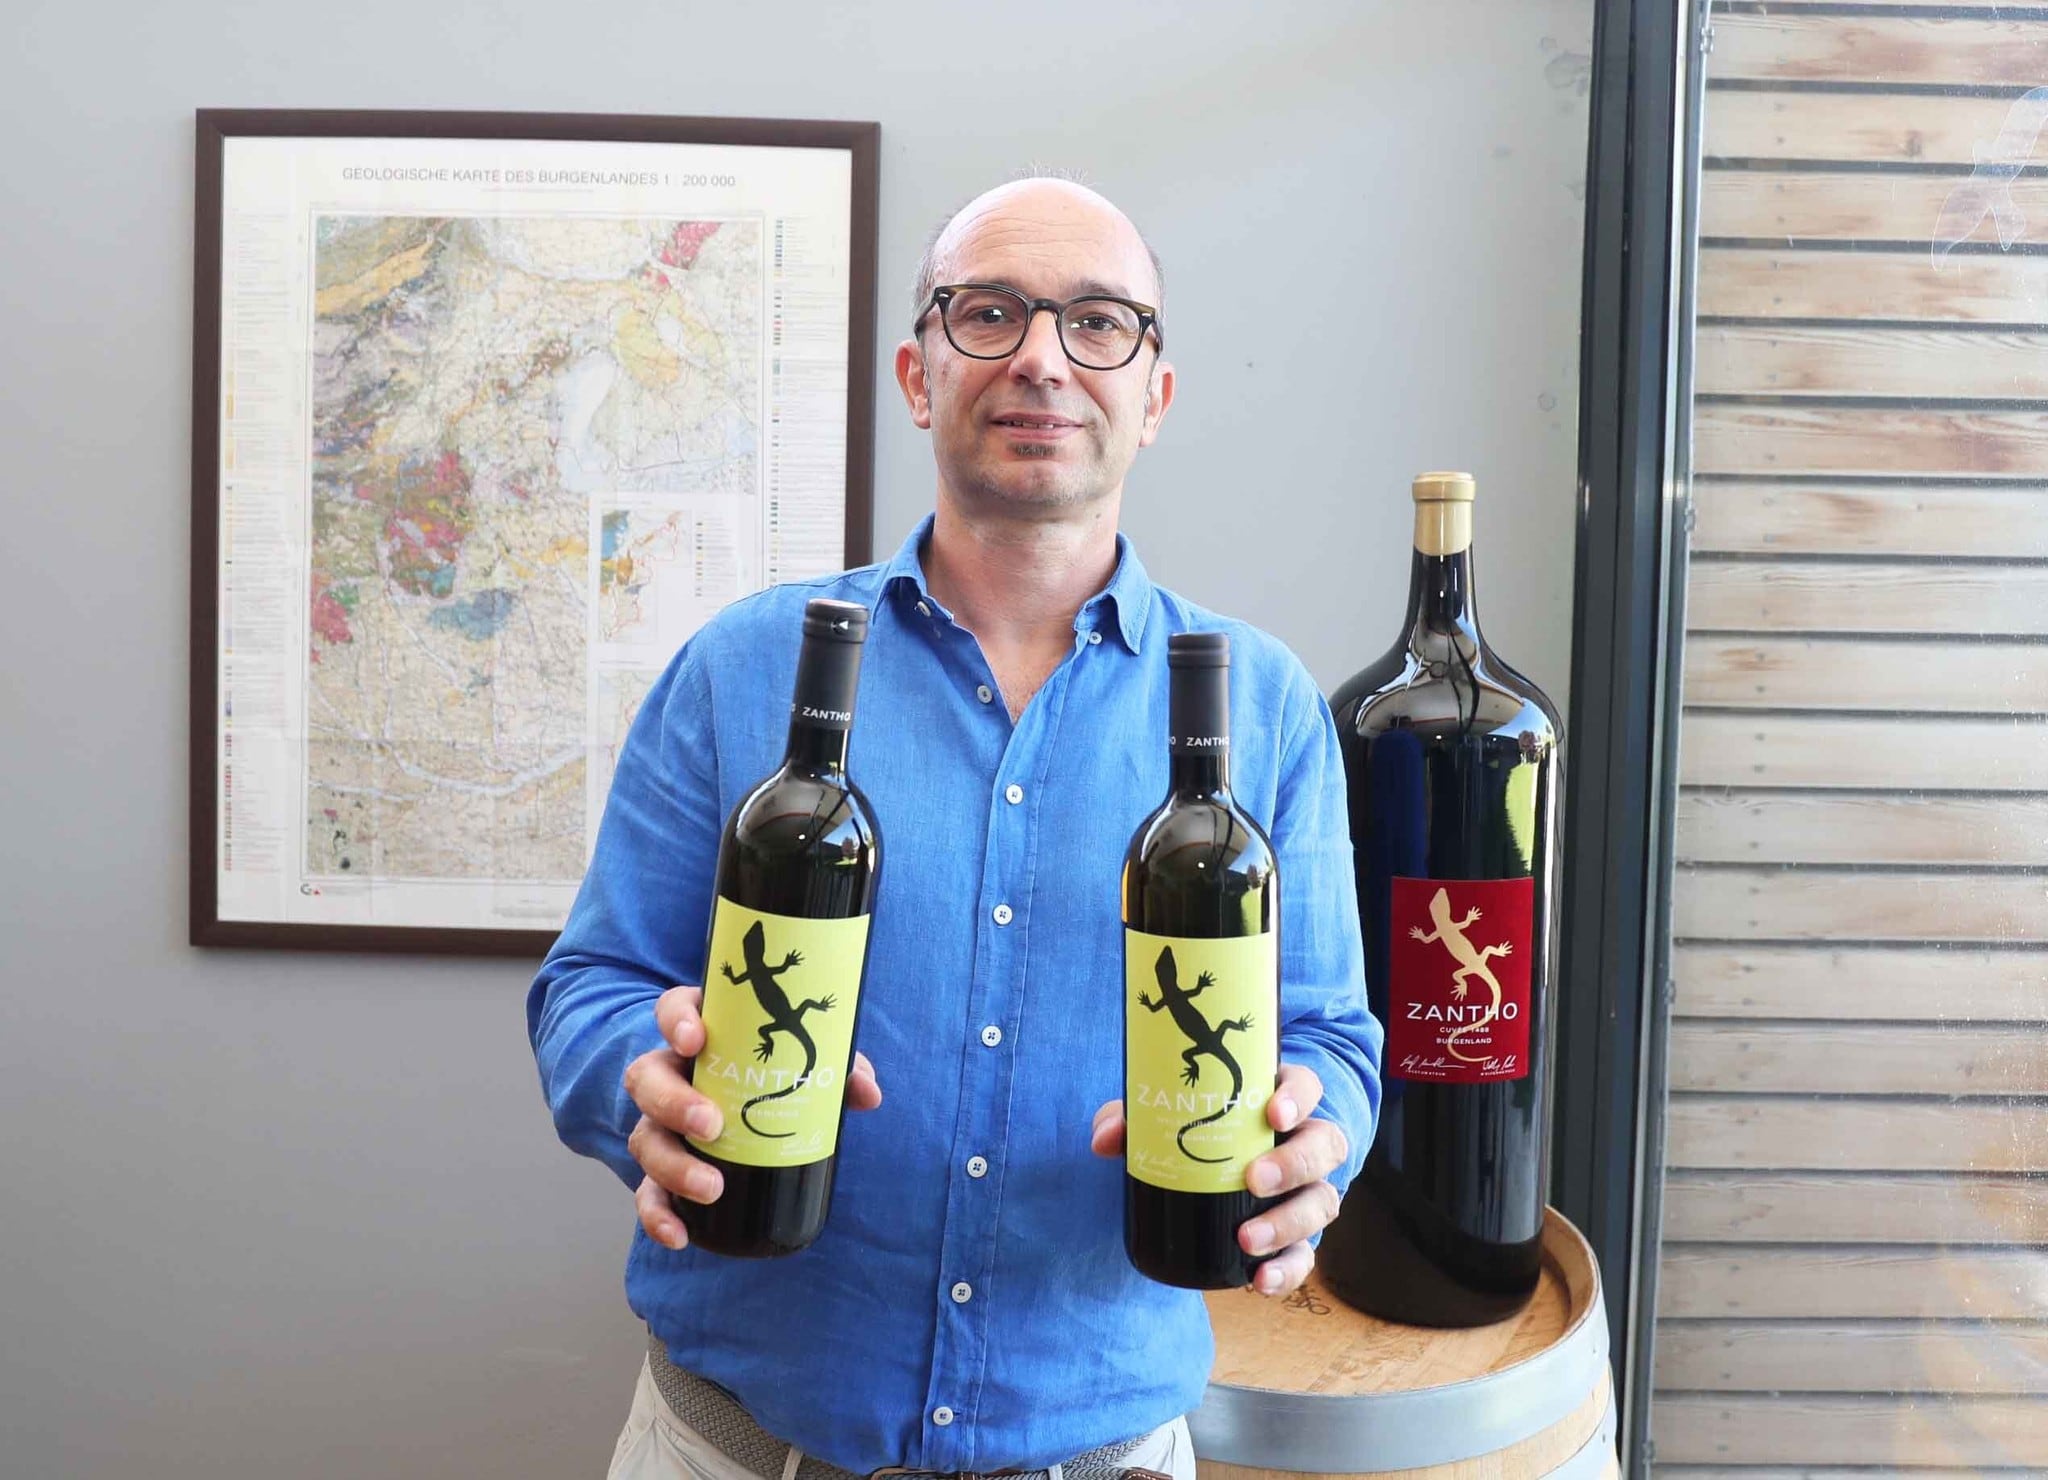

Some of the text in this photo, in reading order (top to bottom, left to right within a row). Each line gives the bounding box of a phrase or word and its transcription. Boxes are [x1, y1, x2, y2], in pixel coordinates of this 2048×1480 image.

[342, 167, 449, 181] GEOLOGISCHE
[453, 168, 501, 182] KARTE
[505, 169, 535, 183] DES
[538, 169, 659, 185] BURGENLANDES
[683, 174, 707, 186] 200
[711, 175, 736, 187] 000
[802, 706, 851, 721] ZANTHO
[1407, 1002, 1518, 1022] ZANTHO
[1436, 1037, 1492, 1045] BURGENLAND
[706, 1054, 835, 1089] ZANTHO
[1137, 1083, 1265, 1113] ZANTHO
